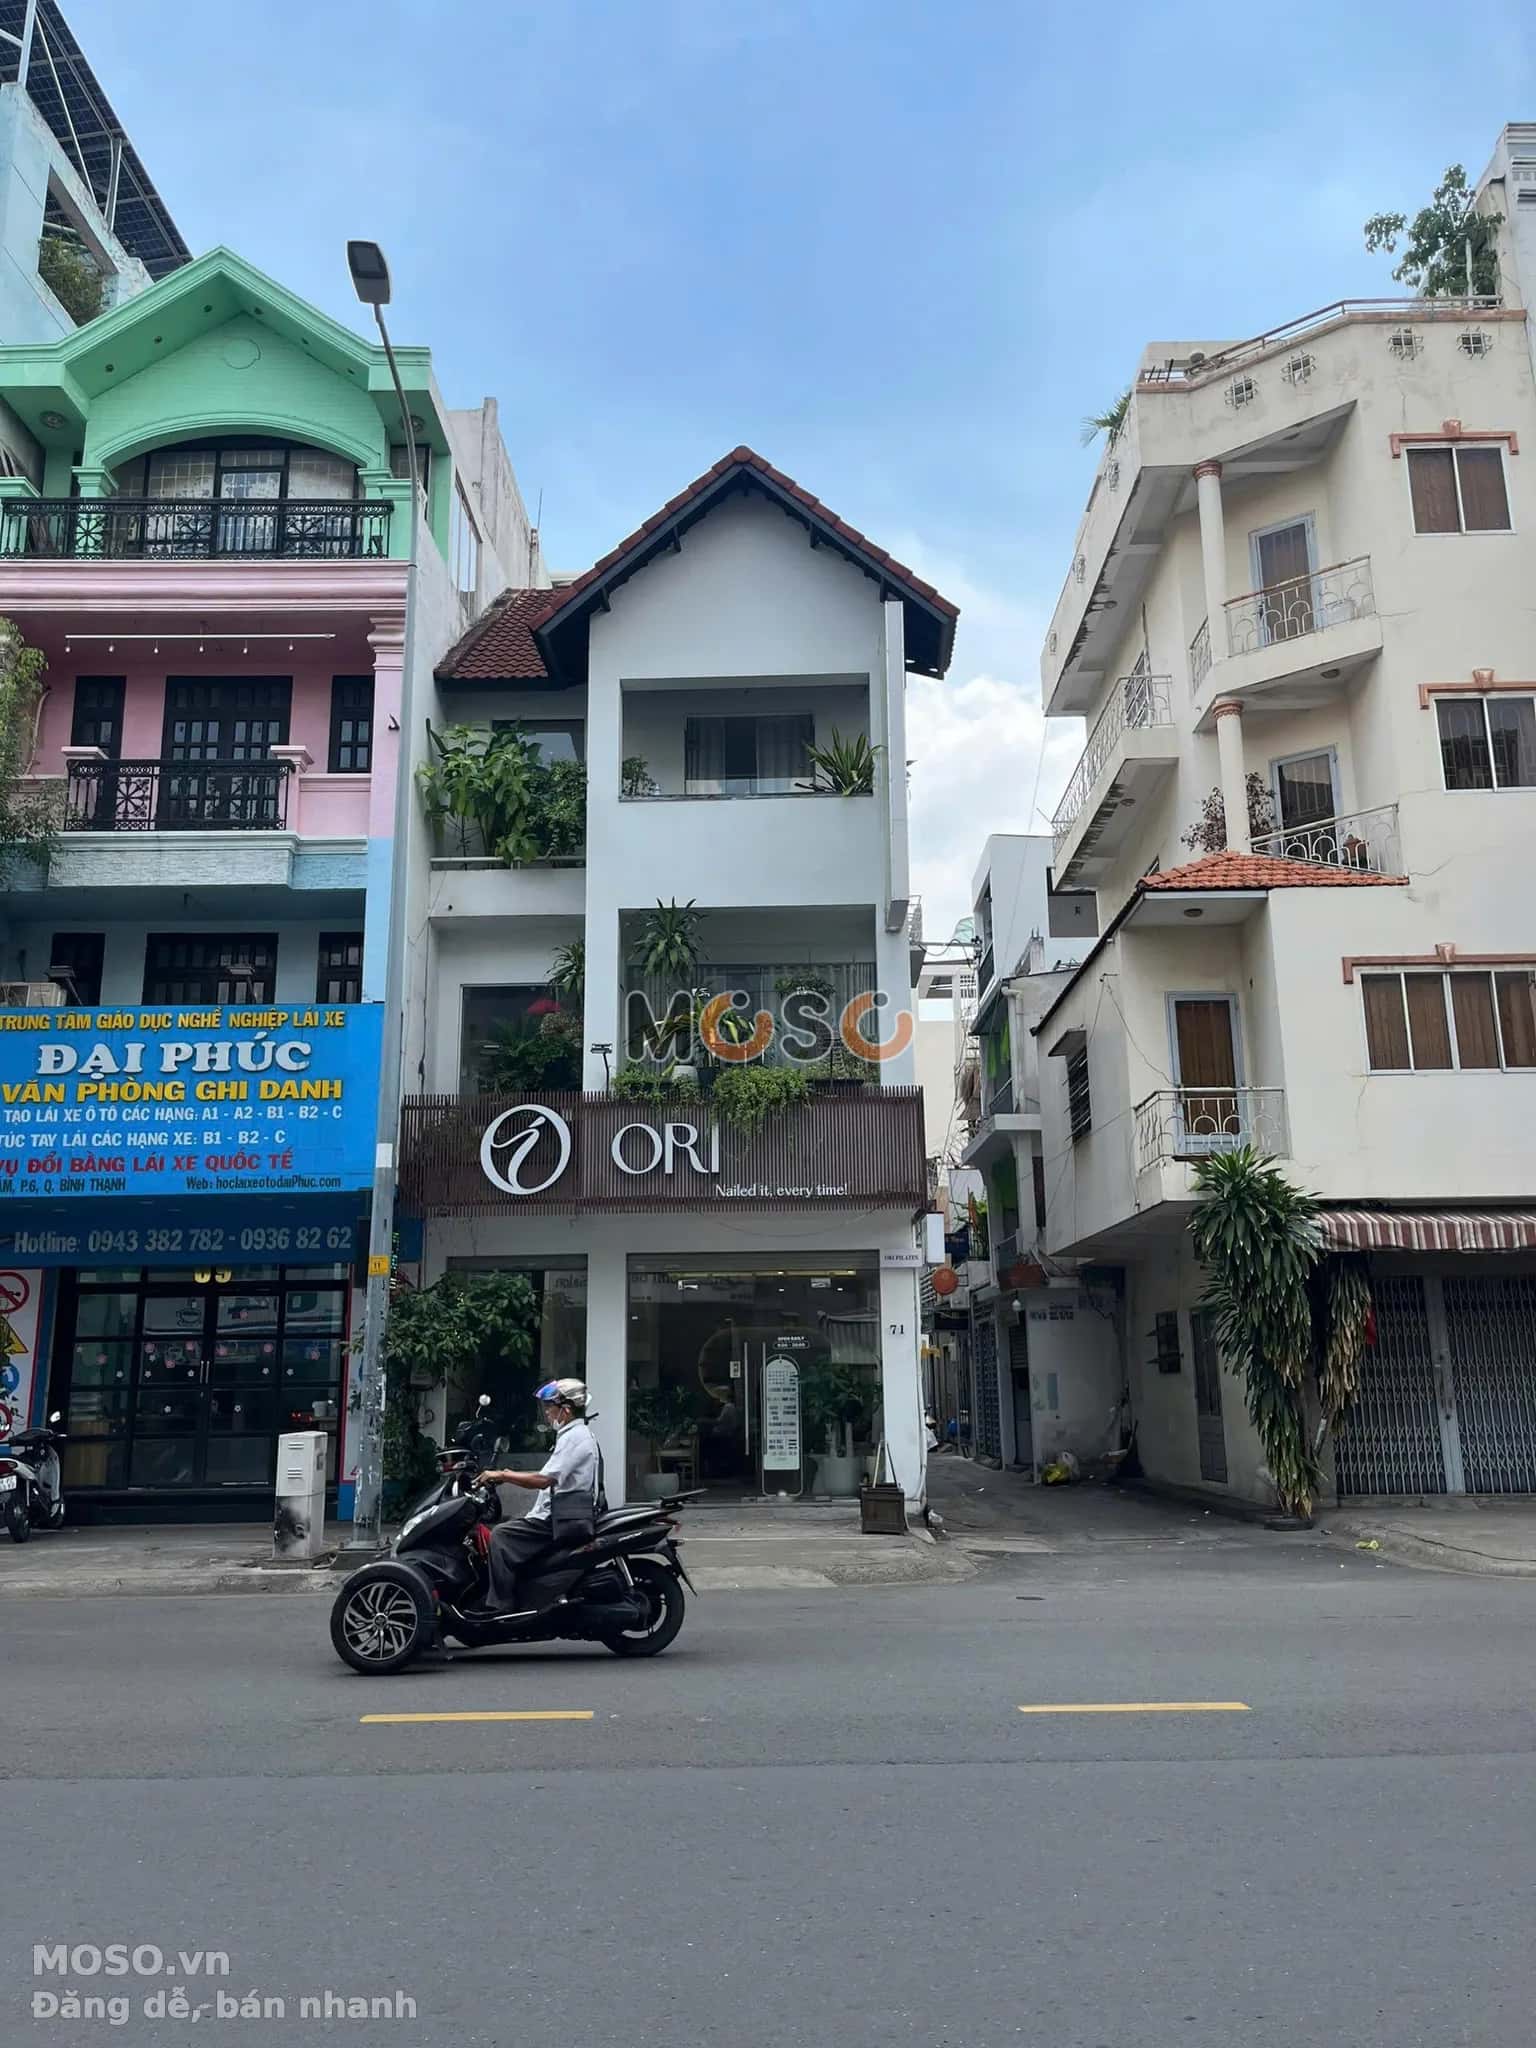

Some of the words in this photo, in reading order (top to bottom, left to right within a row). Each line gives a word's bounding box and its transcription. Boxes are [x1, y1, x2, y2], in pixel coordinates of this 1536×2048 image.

[0, 1013, 50, 1031] TRUNG
[56, 1011, 91, 1030] TÂM
[97, 1010, 134, 1029] GIÁO
[140, 1013, 172, 1034] DỤC
[178, 1007, 222, 1028] NGHỀ
[229, 1008, 288, 1030] NGHIỆP
[293, 1009, 319, 1027] LÁI
[324, 1011, 345, 1026] XE
[36, 1042, 146, 1080] ĐẠI
[159, 1031, 312, 1073] PHÚC
[2, 1079, 65, 1104] VĂN
[76, 1076, 185, 1103] PHÒNG
[195, 1080, 248, 1101] GHI
[259, 1079, 343, 1100] DANH
[4, 1108, 31, 1125] TẠO
[36, 1106, 58, 1123] LÁI
[63, 1108, 82, 1122] XE
[86, 1105, 96, 1122] Ô
[100, 1106, 118, 1122] TÔ
[122, 1104, 150, 1121] CÁC
[154, 1106, 198, 1124] HẠNG:
[202, 1106, 219, 1121] A1
[234, 1106, 253, 1120] A2
[267, 1105, 285, 1119] B1
[299, 1104, 319, 1119] B2
[332, 1104, 342, 1119] C
[31, 1132, 57, 1147] TAY
[62, 1130, 86, 1147] LÁI
[92, 1129, 122, 1147] CÁC
[127, 1131, 168, 1149] HẠNG
[173, 1131, 197, 1146] XE:
[203, 1130, 221, 1145] B1
[238, 1130, 260, 1144] B2
[275, 1129, 286, 1143] C
[611, 1122, 719, 1175] ORI
[27, 1150, 61, 1174] ĐỔI
[70, 1150, 125, 1173] BẰNG
[132, 1151, 165, 1173] LÁI
[172, 1154, 198, 1171] XE
[204, 1148, 260, 1173] QUỐC
[268, 1146, 294, 1170] TẾ
[60, 1175, 85, 1193] BÌNH
[90, 1176, 126, 1194] THẠNH
[715, 1182, 756, 1198] Nailed
[760, 1183, 773, 1198] it,
[777, 1185, 813, 1198] every
[816, 1182, 848, 1197] time!
[14, 1230, 80, 1254] Hotline:
[88, 1228, 138, 1252] 0943
[144, 1228, 183, 1252] 382
[188, 1227, 224, 1251] 782
[240, 1227, 290, 1250] 0936
[295, 1226, 321, 1249] 82
[326, 1226, 352, 1249] 62
[889, 1323, 905, 1336] 71
